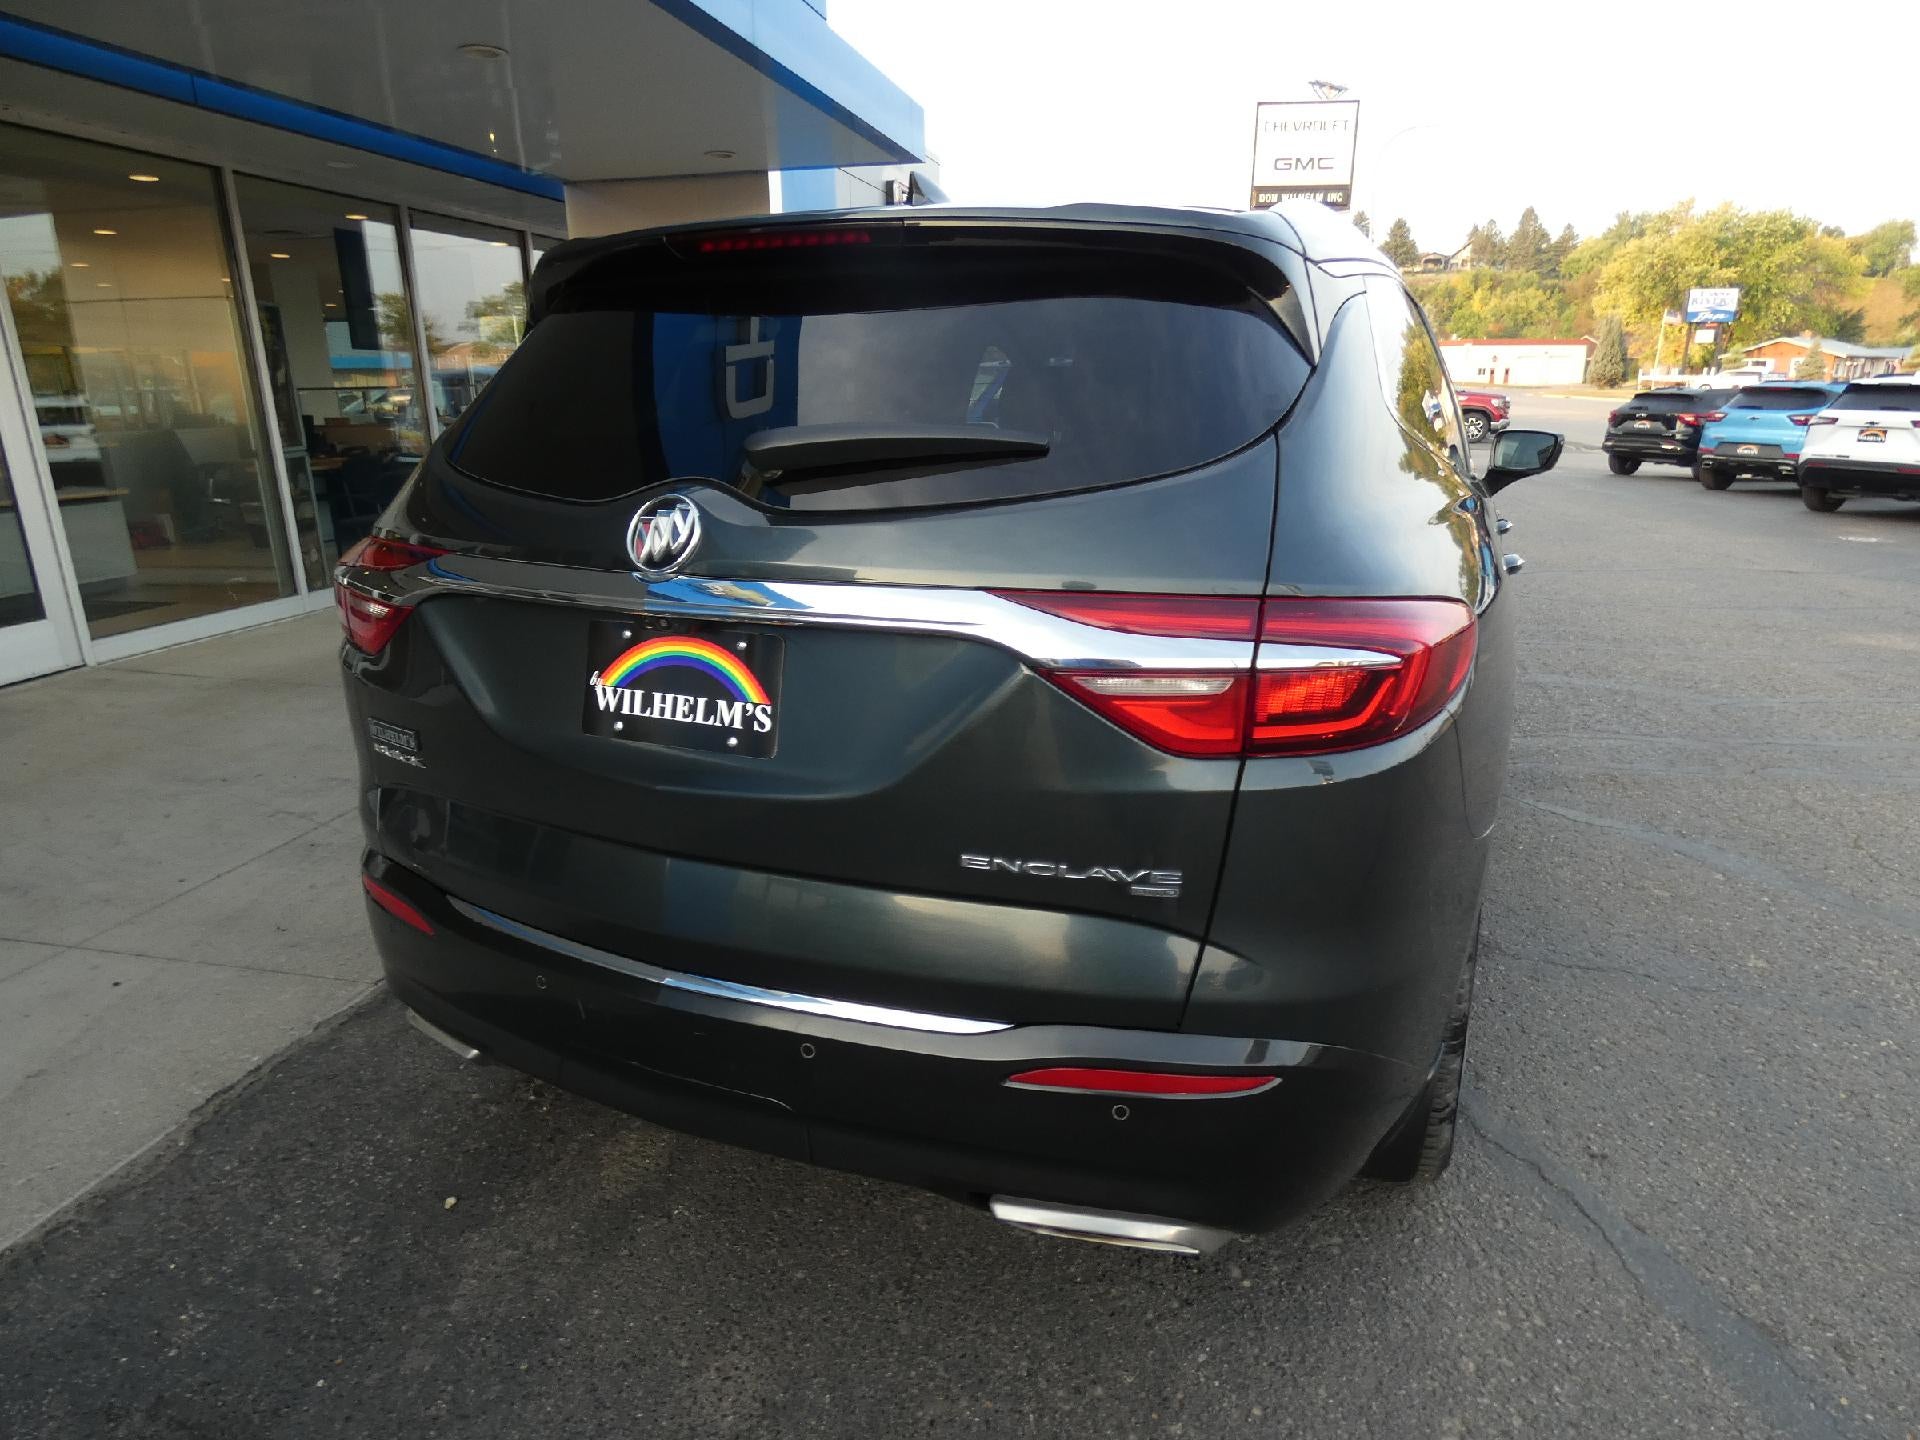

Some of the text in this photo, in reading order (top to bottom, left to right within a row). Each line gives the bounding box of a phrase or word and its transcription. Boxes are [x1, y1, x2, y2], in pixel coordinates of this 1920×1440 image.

[1273, 157, 1335, 171] GMC
[595, 685, 772, 733] WILHELM'S
[960, 853, 1183, 884] ENCLAVE
